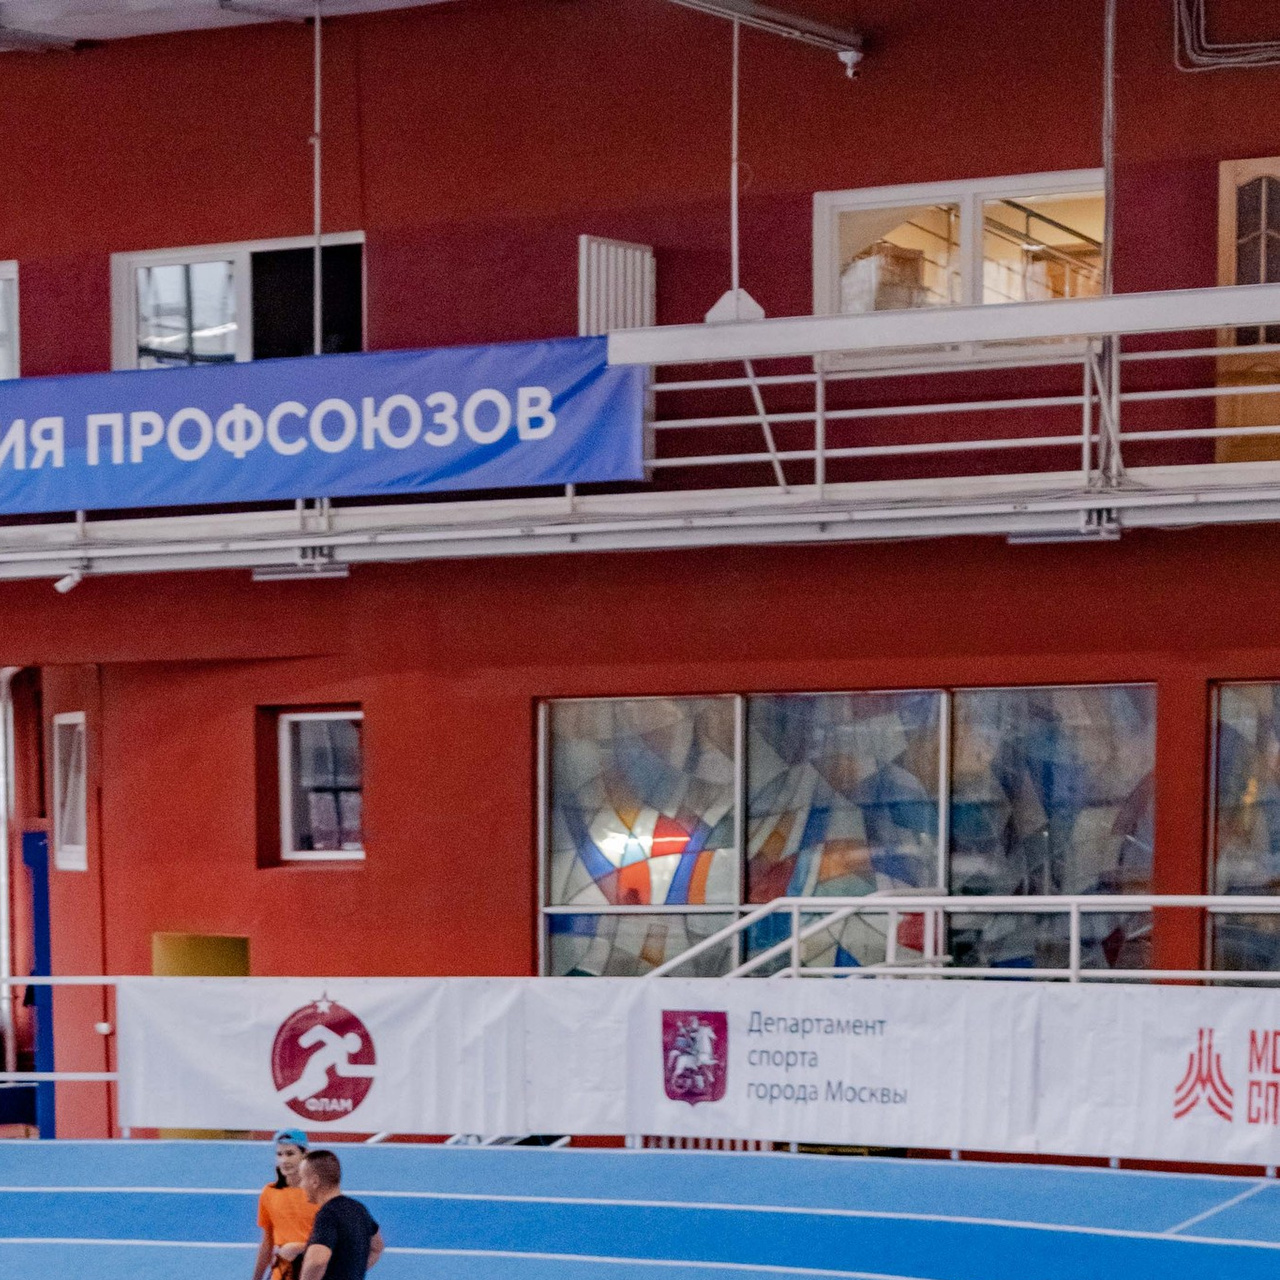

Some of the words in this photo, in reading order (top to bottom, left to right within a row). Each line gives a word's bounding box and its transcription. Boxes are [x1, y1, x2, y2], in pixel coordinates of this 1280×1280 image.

[86, 385, 557, 466] ПРОФСОЮЗОВ
[747, 1010, 887, 1037] Департамент
[748, 1049, 818, 1072] спорта
[747, 1081, 818, 1105] города
[825, 1080, 907, 1104] Москвы
